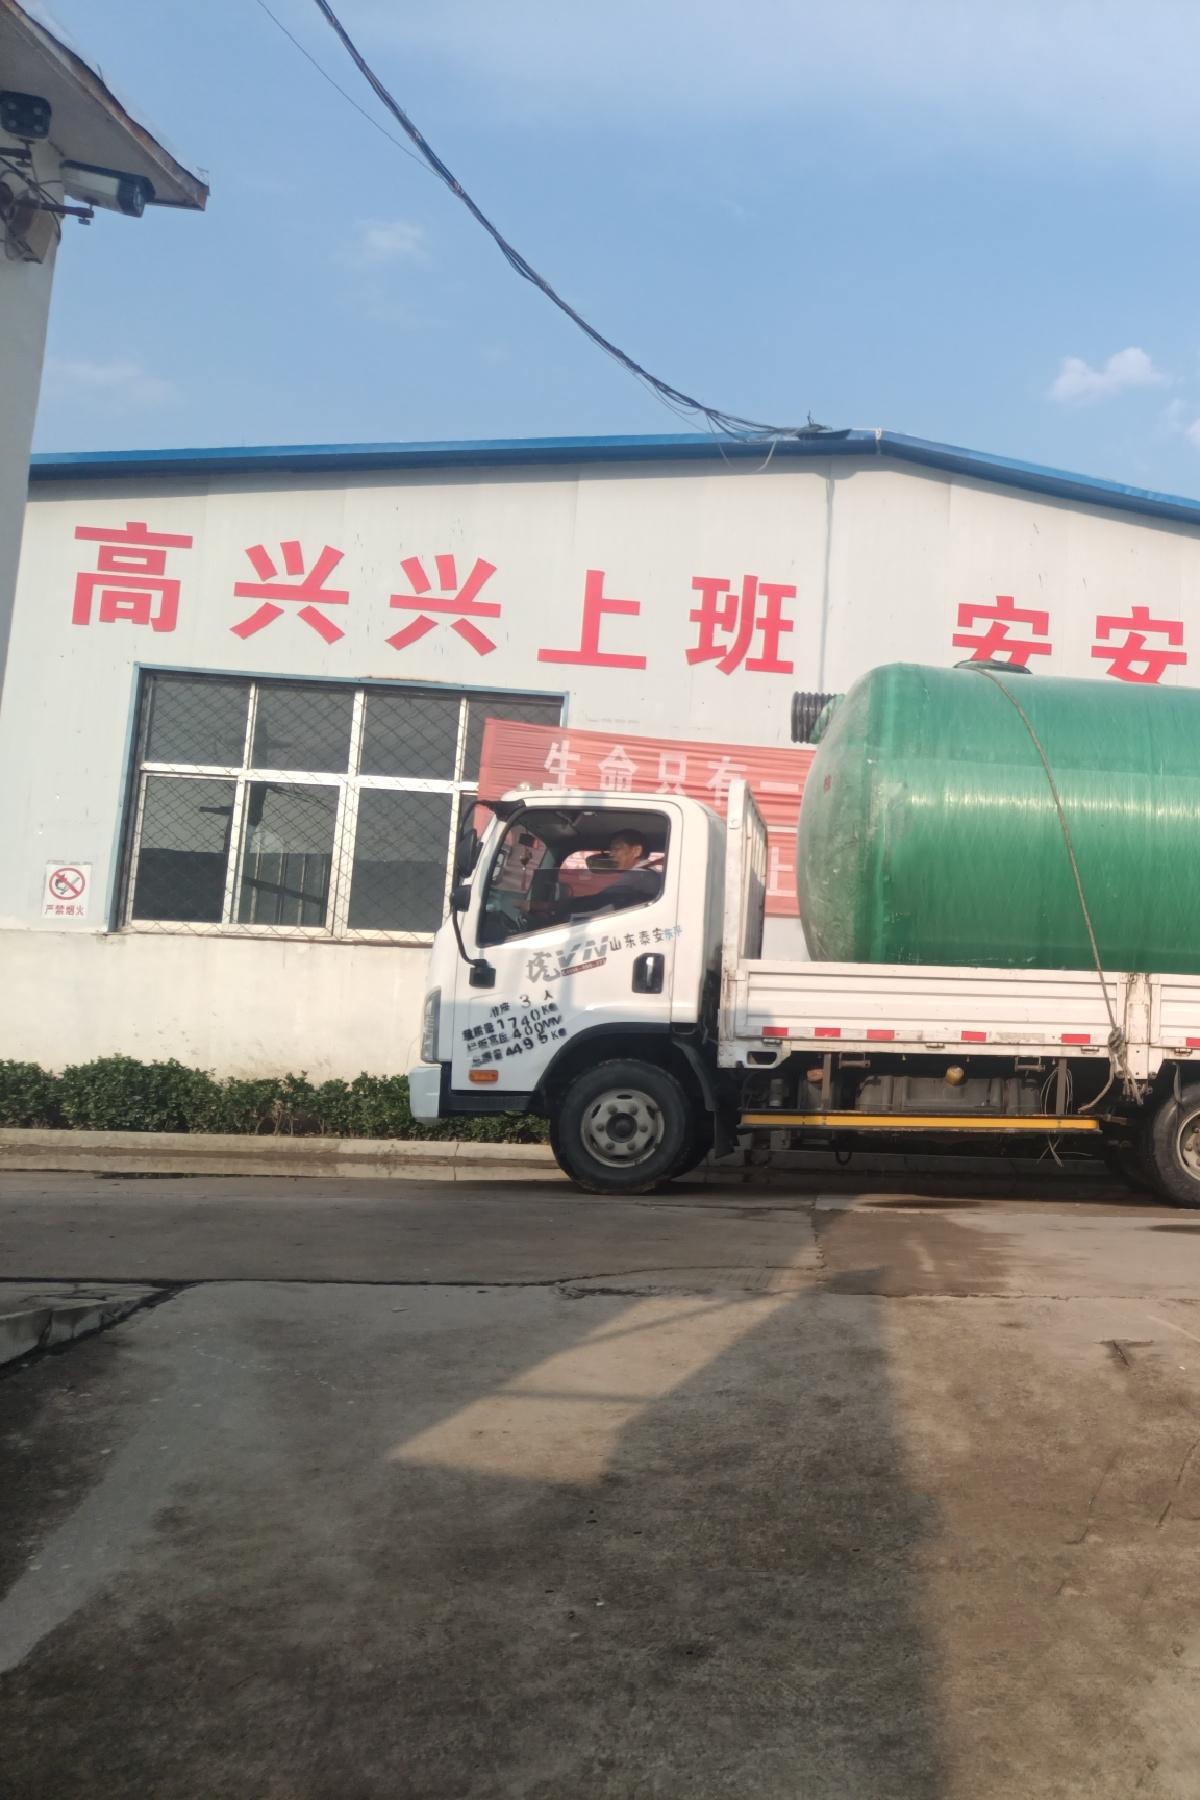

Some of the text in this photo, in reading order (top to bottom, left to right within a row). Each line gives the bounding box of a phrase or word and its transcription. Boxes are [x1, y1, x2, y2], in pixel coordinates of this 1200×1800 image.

[72, 521, 797, 675] 高兴兴上班
